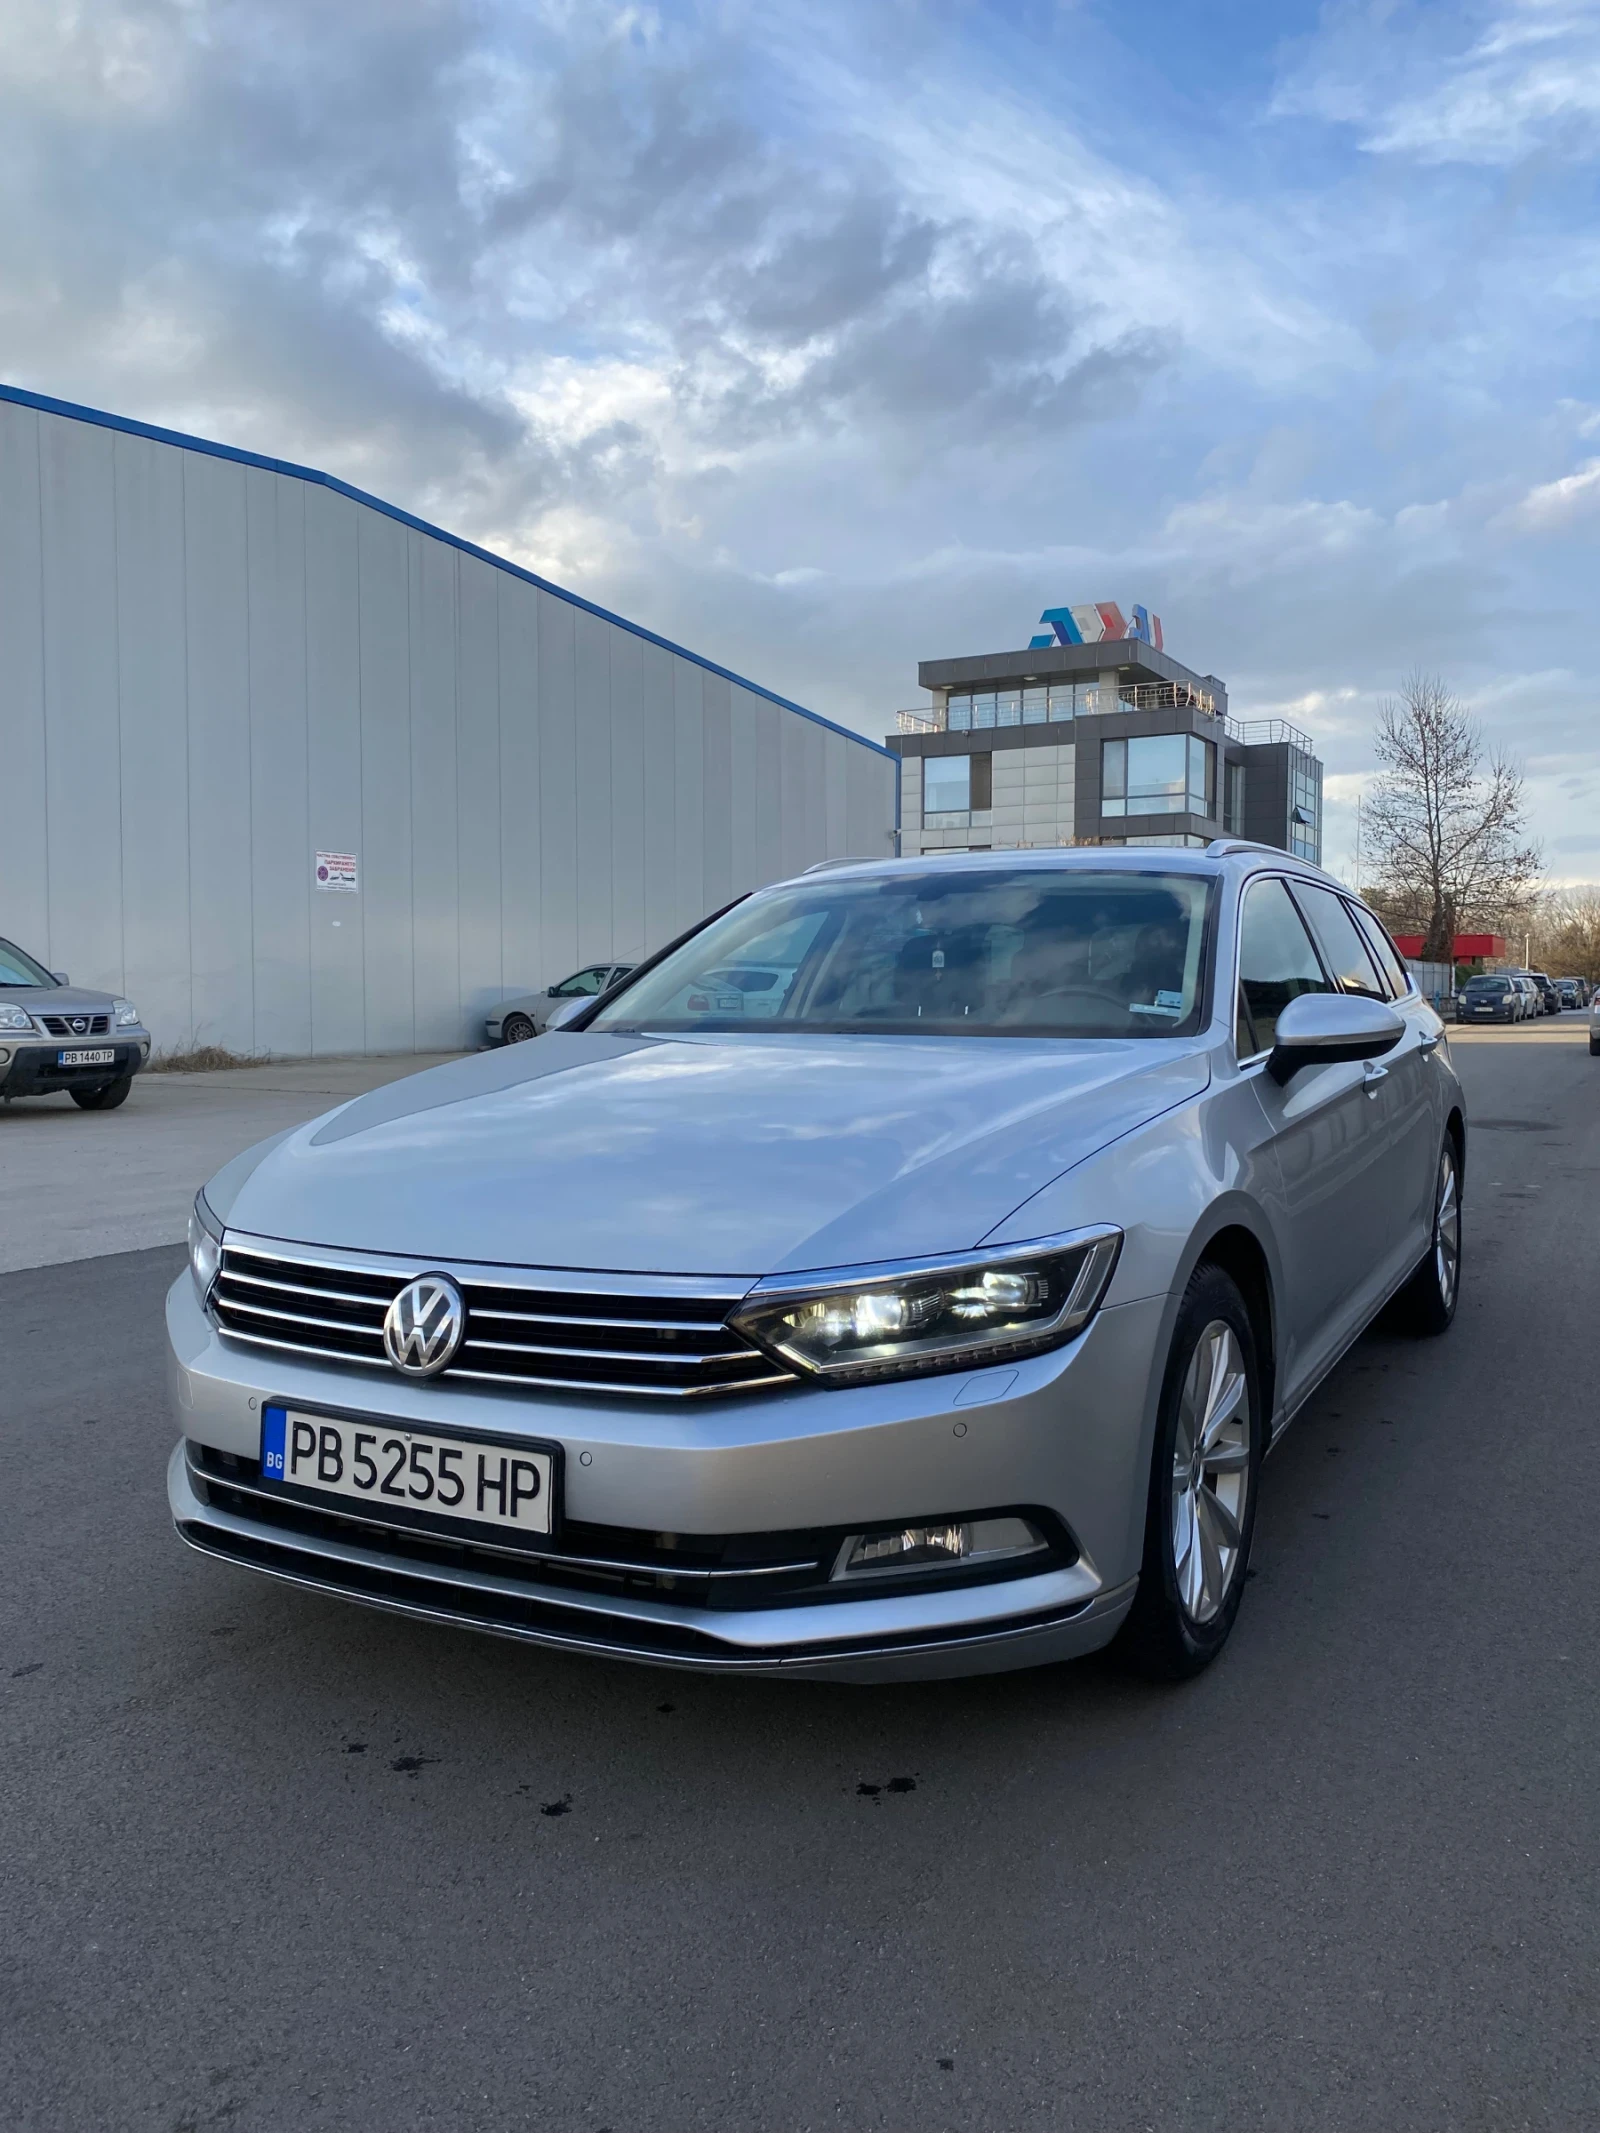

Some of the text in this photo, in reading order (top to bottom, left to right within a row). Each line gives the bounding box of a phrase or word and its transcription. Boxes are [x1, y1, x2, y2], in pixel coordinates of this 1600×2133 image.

[65, 1051, 112, 1063] PB 1440 TP
[388, 1282, 456, 1370] VW
[266, 1451, 283, 1470] BG
[291, 1421, 541, 1518] PB 5255 HP
